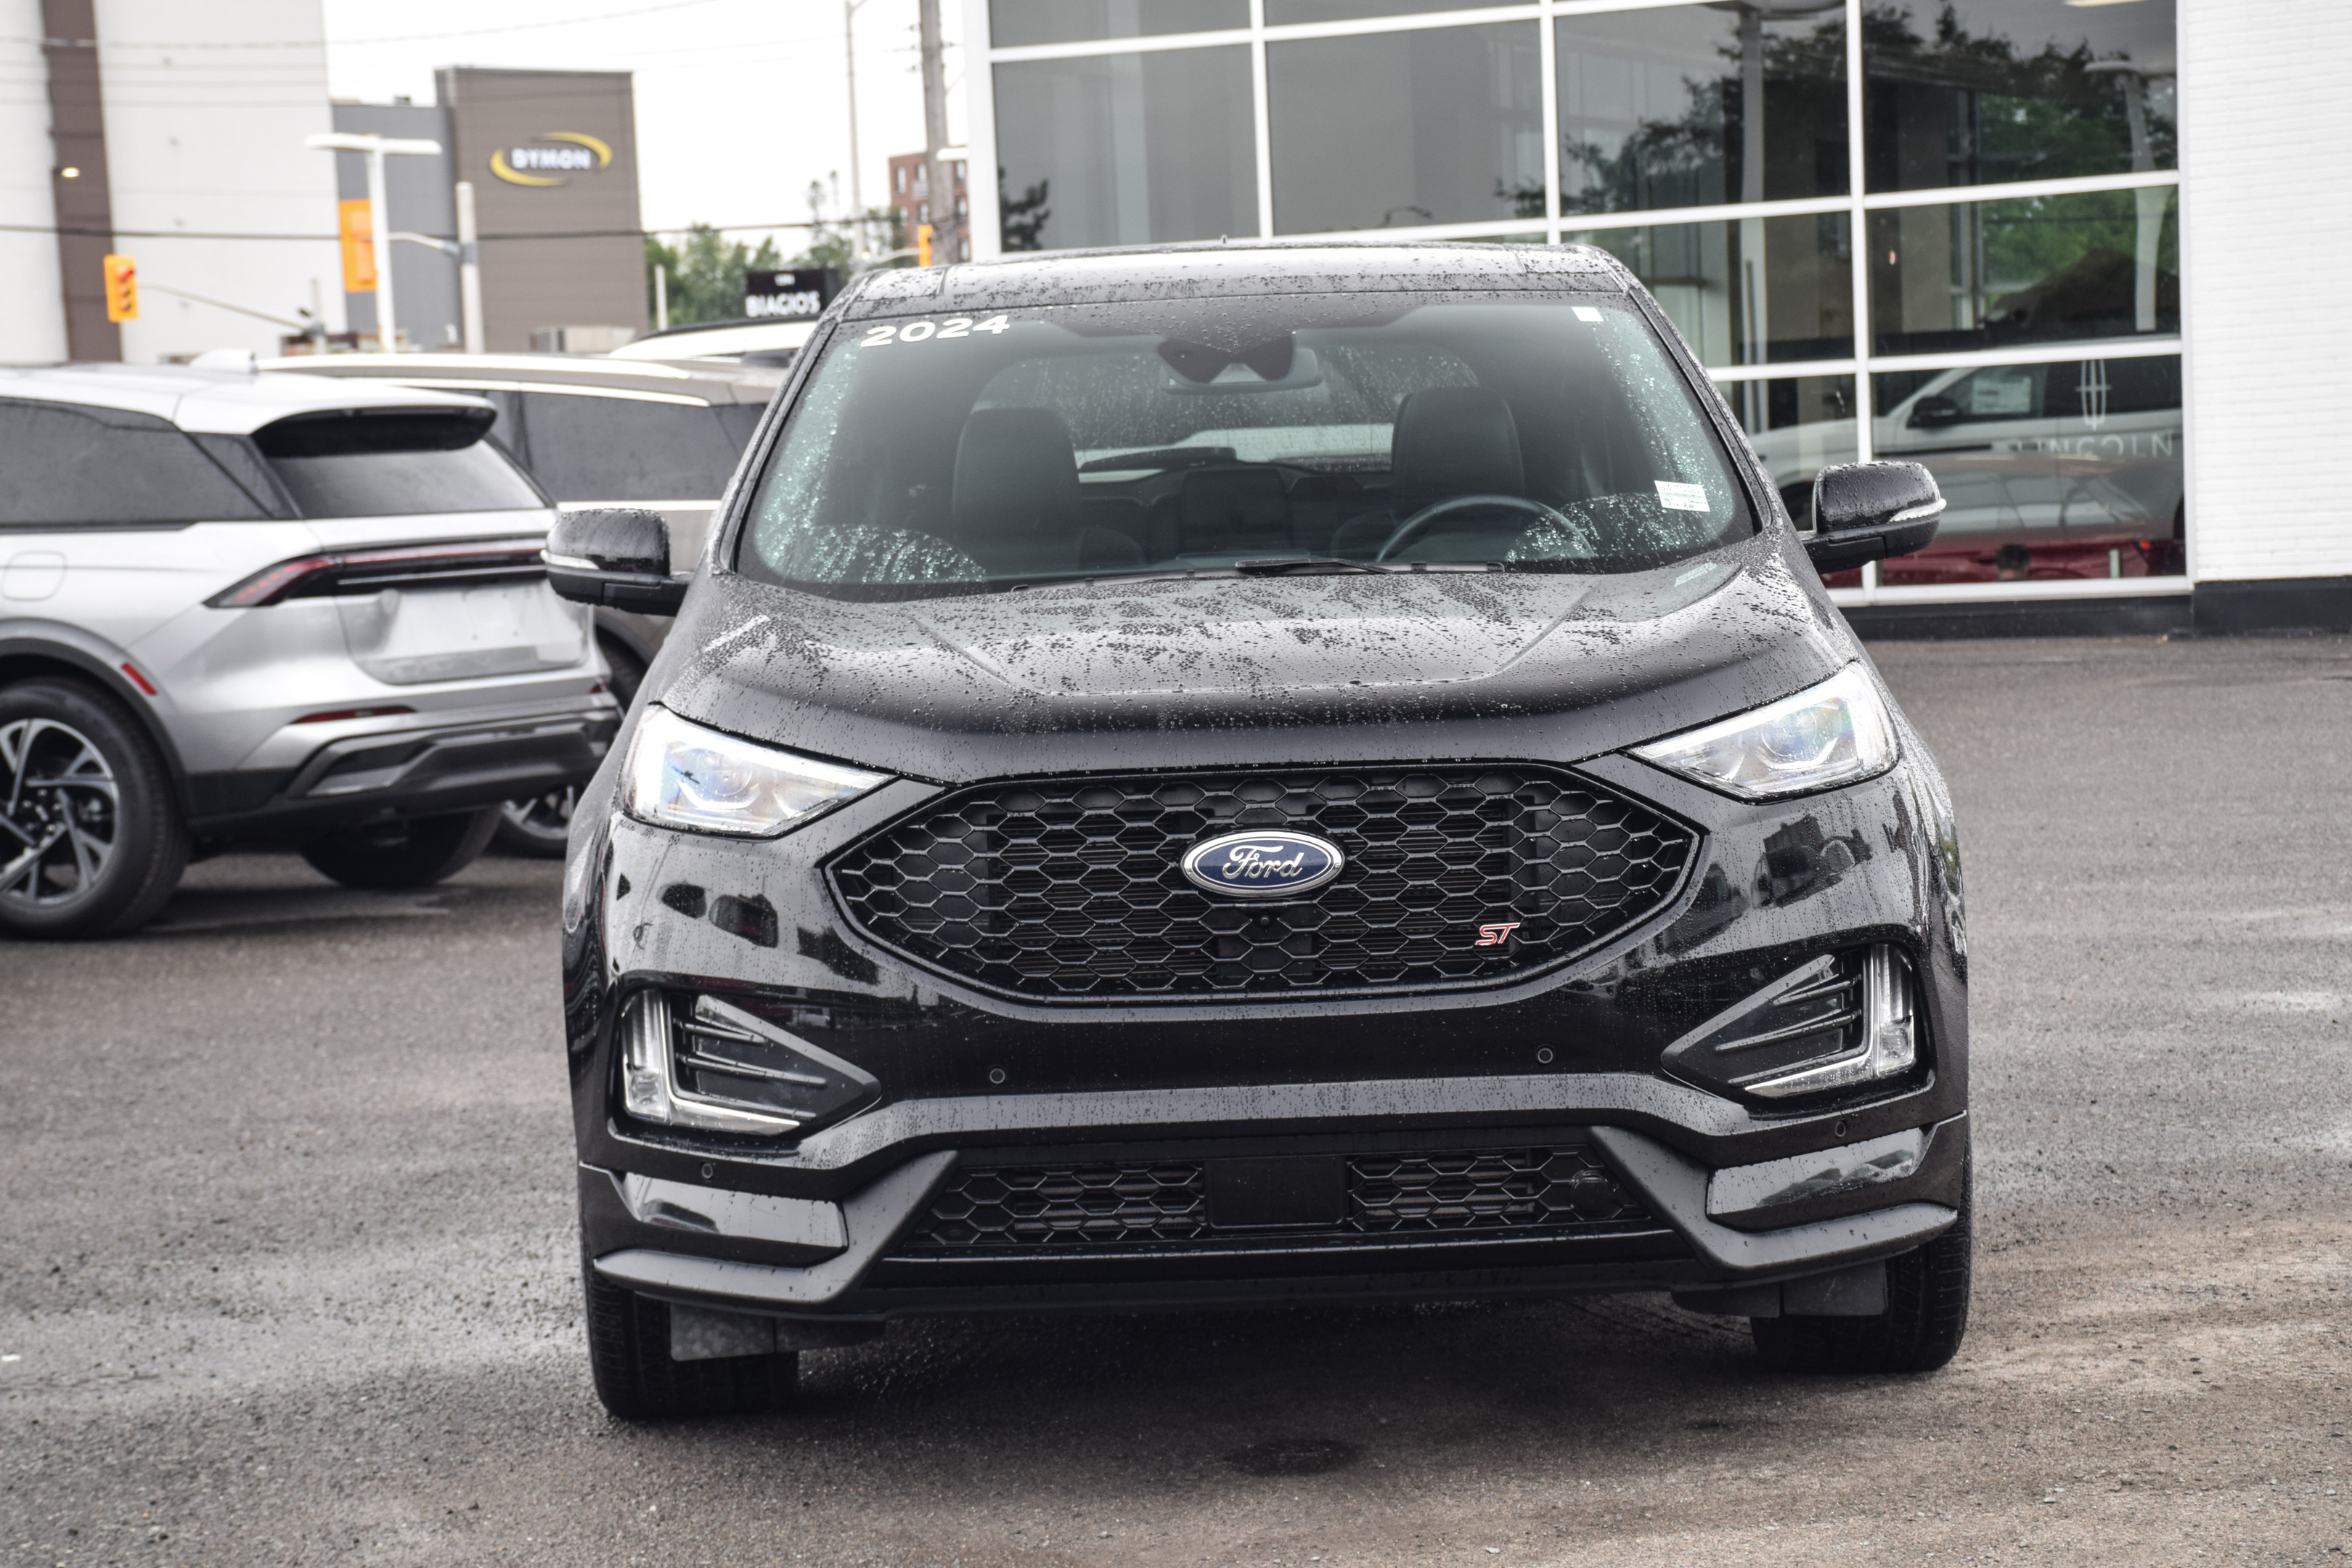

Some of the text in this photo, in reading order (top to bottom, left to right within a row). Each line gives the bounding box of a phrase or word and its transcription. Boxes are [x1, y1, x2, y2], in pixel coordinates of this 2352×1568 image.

[511, 148, 591, 169] DYMON
[860, 314, 1010, 347] 2024
[1222, 845, 1304, 879] Ford
[1475, 923, 1521, 946] ST
